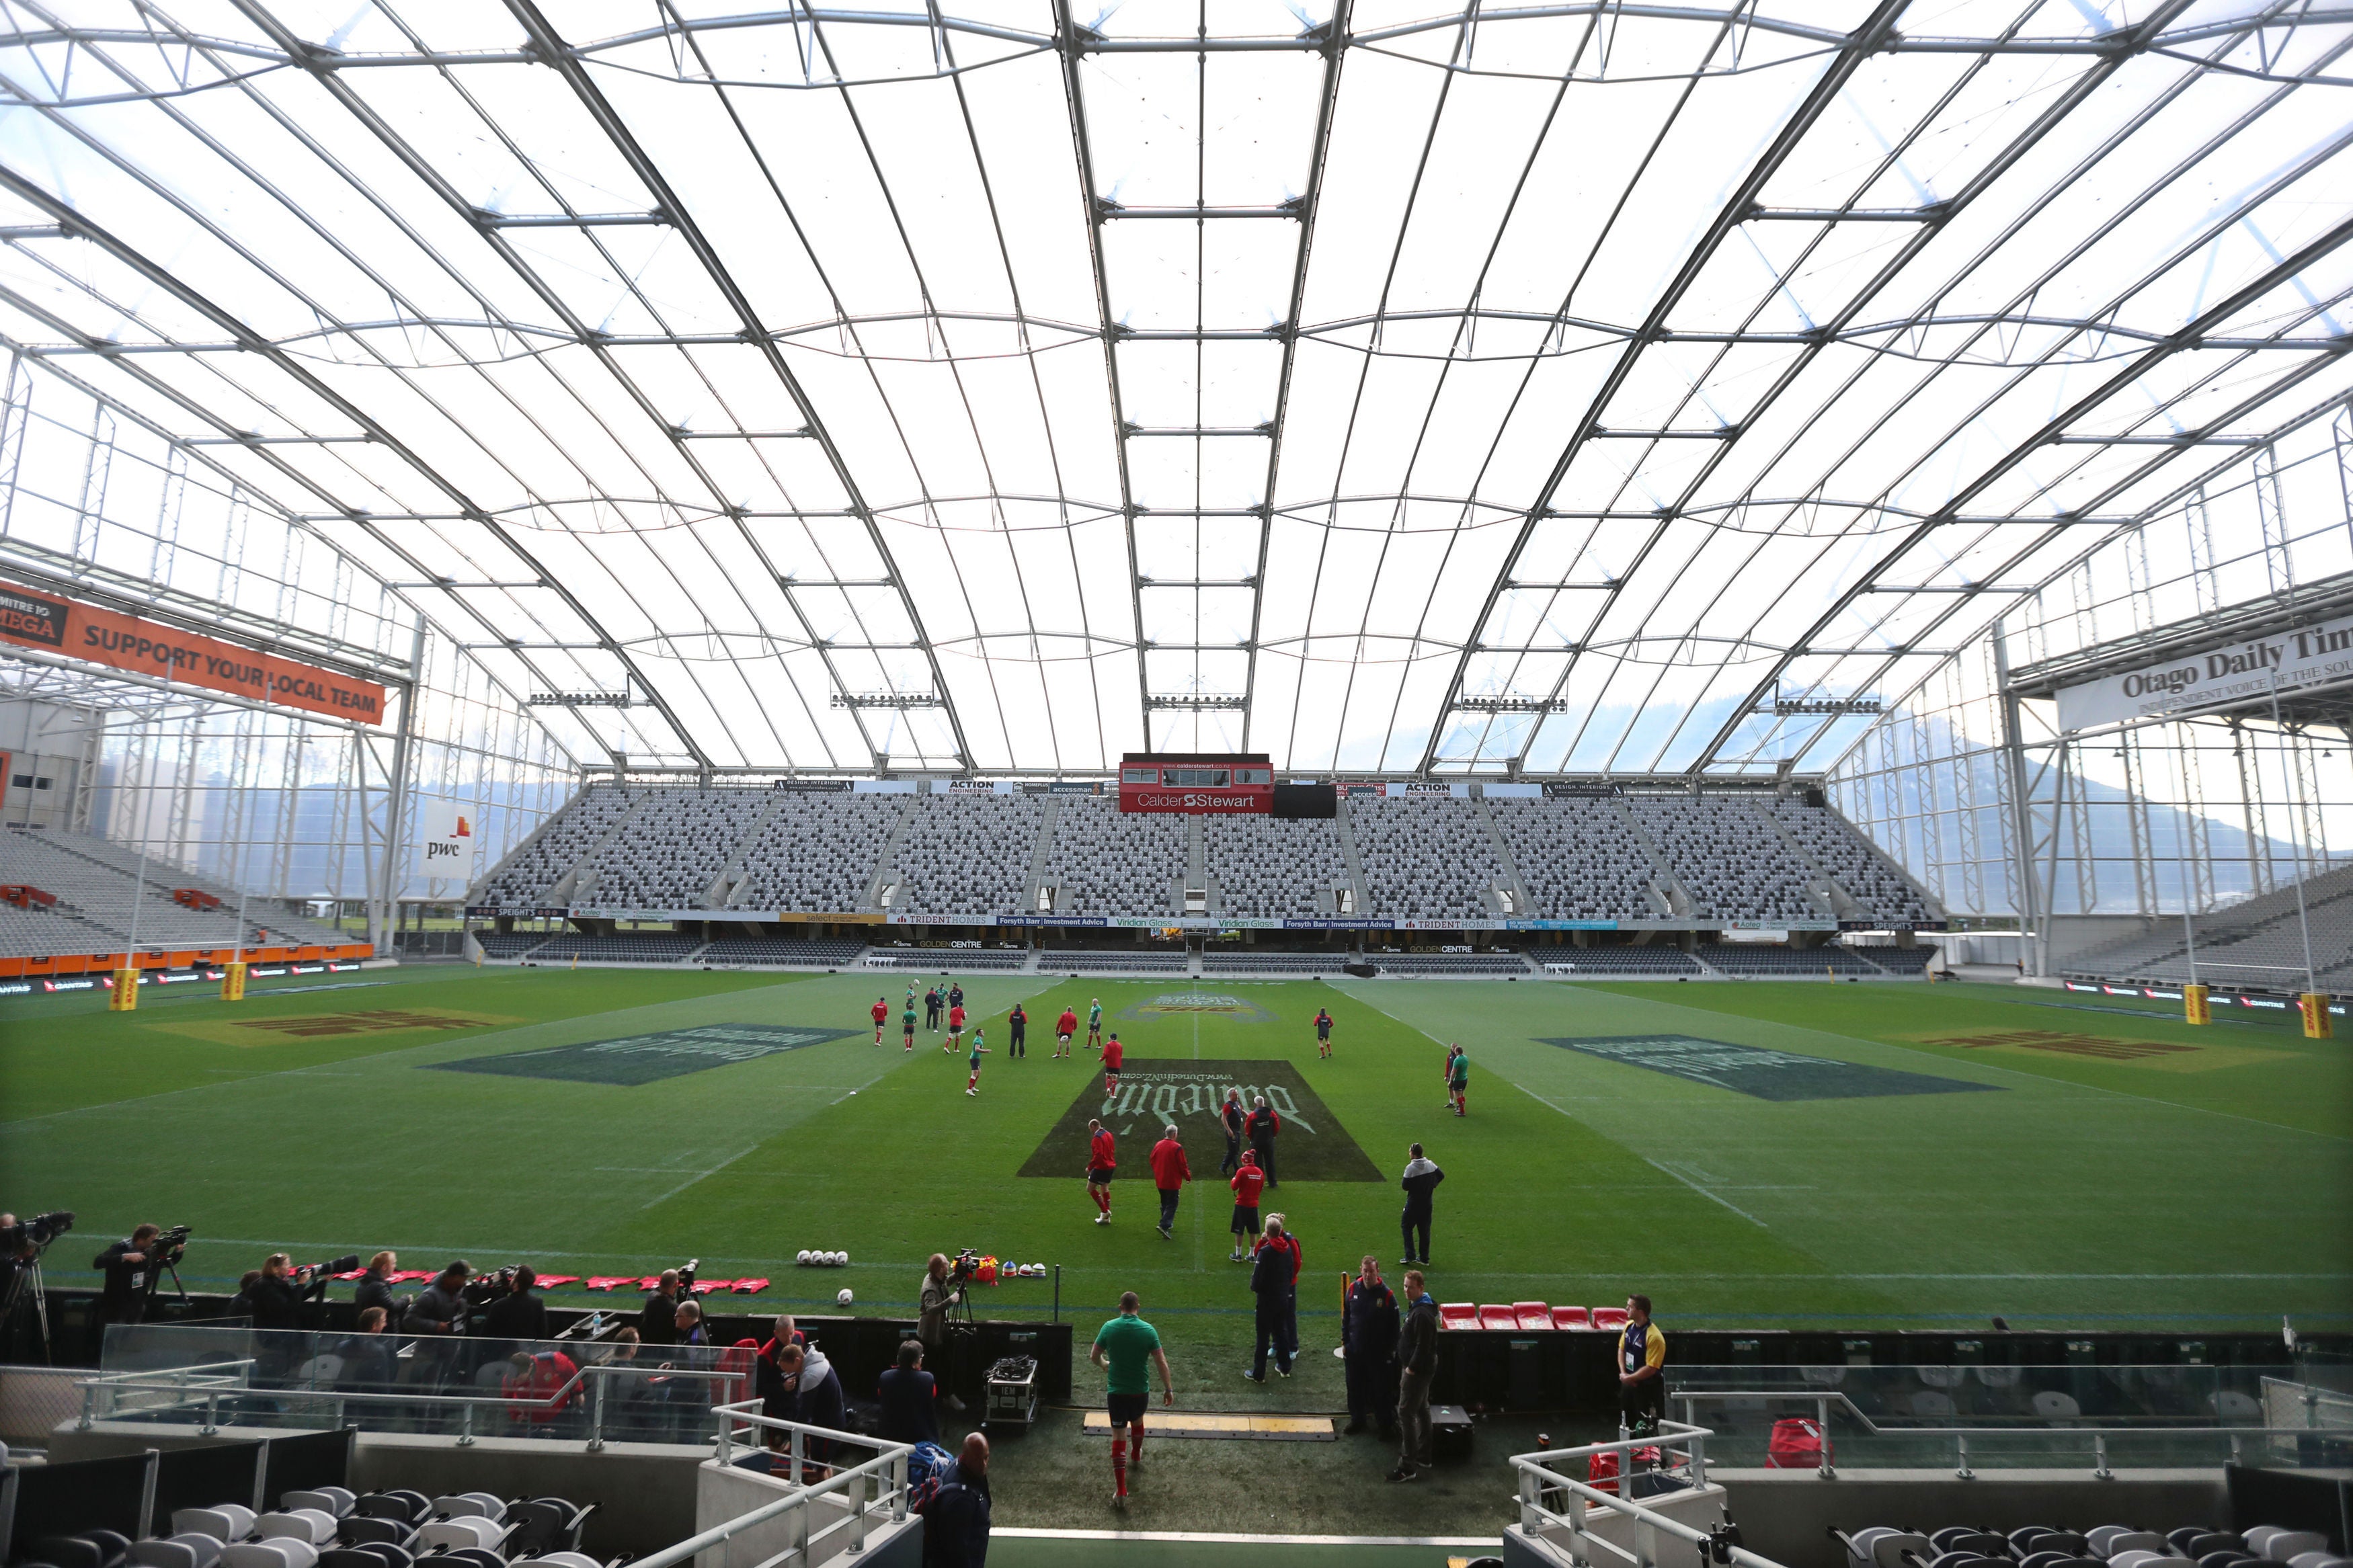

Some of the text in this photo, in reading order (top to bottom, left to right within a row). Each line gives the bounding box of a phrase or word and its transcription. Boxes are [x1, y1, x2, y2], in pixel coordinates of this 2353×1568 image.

[35, 606, 50, 617] 10
[84, 625, 375, 713] SUPPORT YOUR LOCAL TEAM
[2123, 665, 2199, 698] Otago
[2205, 642, 2285, 681] Daily
[2139, 689, 2228, 714] INDEPENDENT
[2225, 677, 2266, 695] VOICE
[2290, 666, 2321, 682] THE
[1138, 793, 1254, 807] Calder Stewart
[426, 841, 460, 860] pwc
[498, 908, 535, 916] SPEIGHT'S
[1117, 918, 1172, 927] Viridian Glass
[1218, 919, 1274, 927] Viridian Glass
[54, 981, 93, 989] QANTAS
[2250, 1000, 2286, 1008] QANTAS
[2306, 1001, 2315, 1031] DHL
[1119, 1073, 1233, 1082] www.DunedinNZ.com
[1002, 1387, 1016, 1395] IEM
